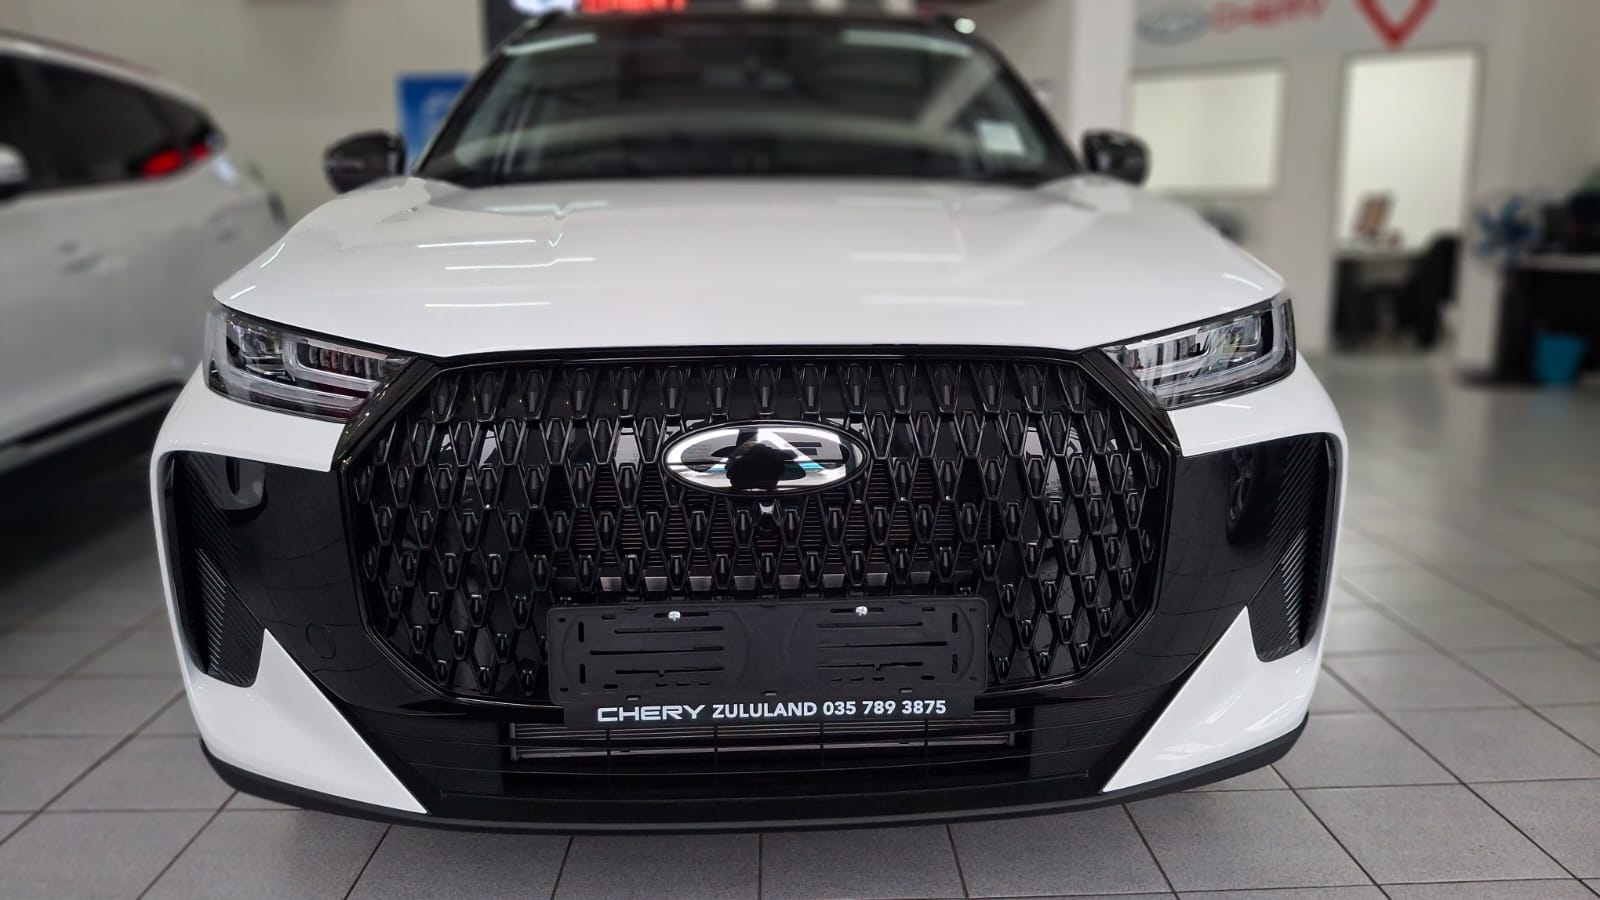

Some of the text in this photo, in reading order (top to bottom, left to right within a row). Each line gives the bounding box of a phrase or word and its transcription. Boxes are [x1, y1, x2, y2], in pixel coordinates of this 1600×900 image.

[597, 699, 947, 722] CHERY ZULULAND 035 789 3875
